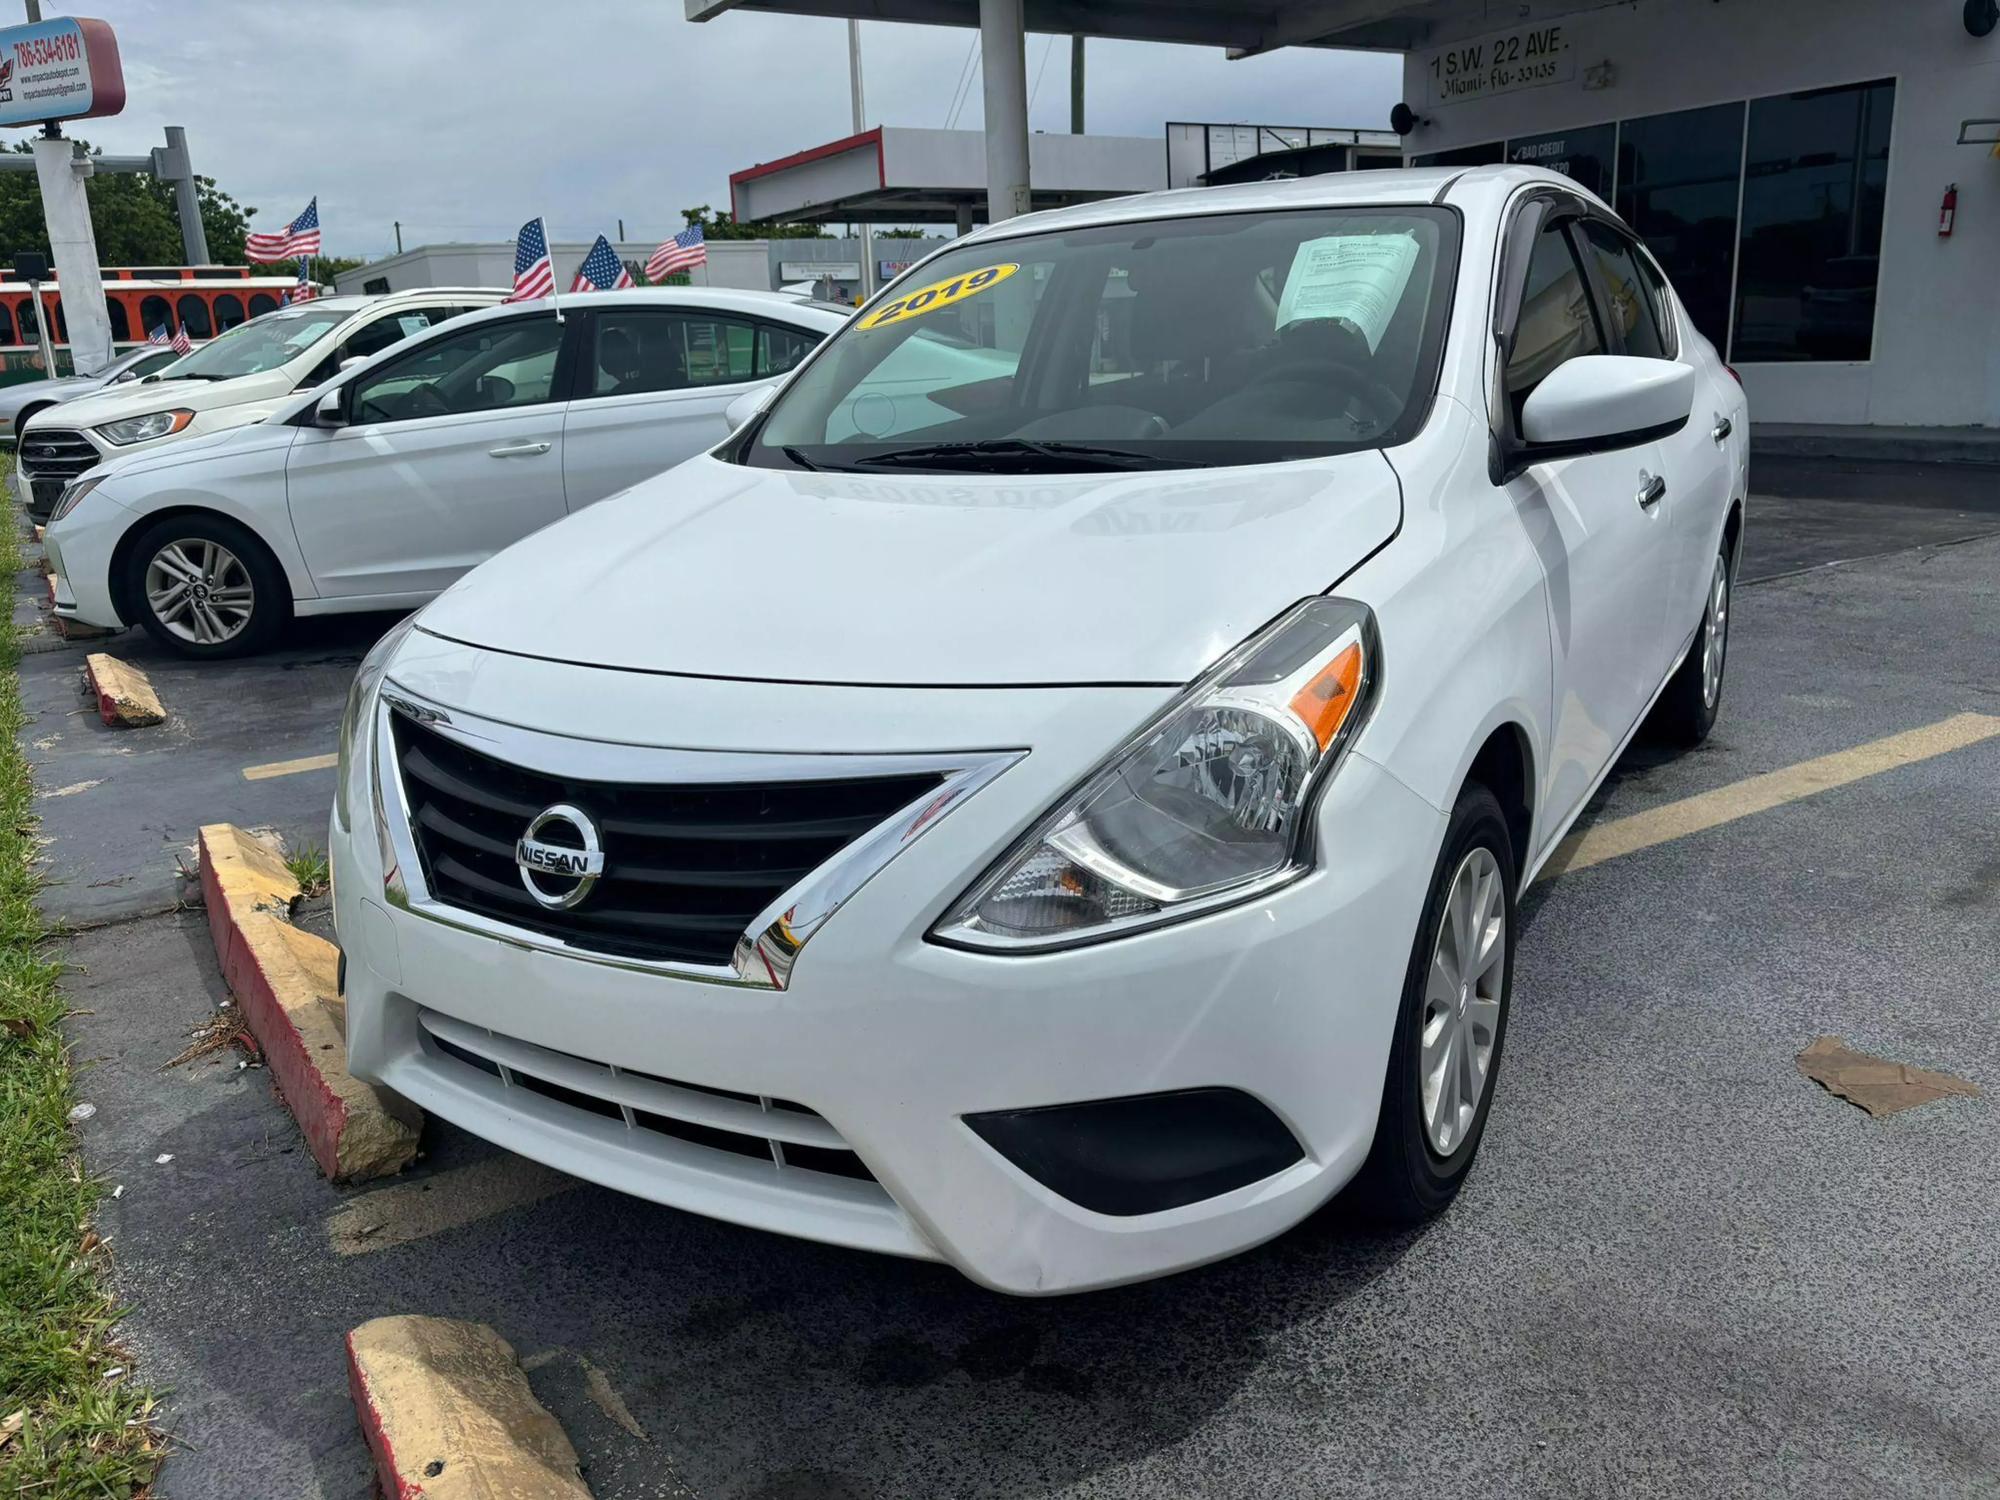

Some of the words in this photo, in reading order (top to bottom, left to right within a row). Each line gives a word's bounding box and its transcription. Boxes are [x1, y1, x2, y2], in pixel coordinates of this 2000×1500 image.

[13, 32, 81, 69] 786-534-6181
[1446, 45, 1484, 75] S.W.
[1493, 36, 1520, 65] 22
[1521, 144, 1537, 160] BAD
[1538, 139, 1565, 157] CREDIT
[870, 268, 999, 327] 2019
[518, 840, 589, 872] NISSAN
